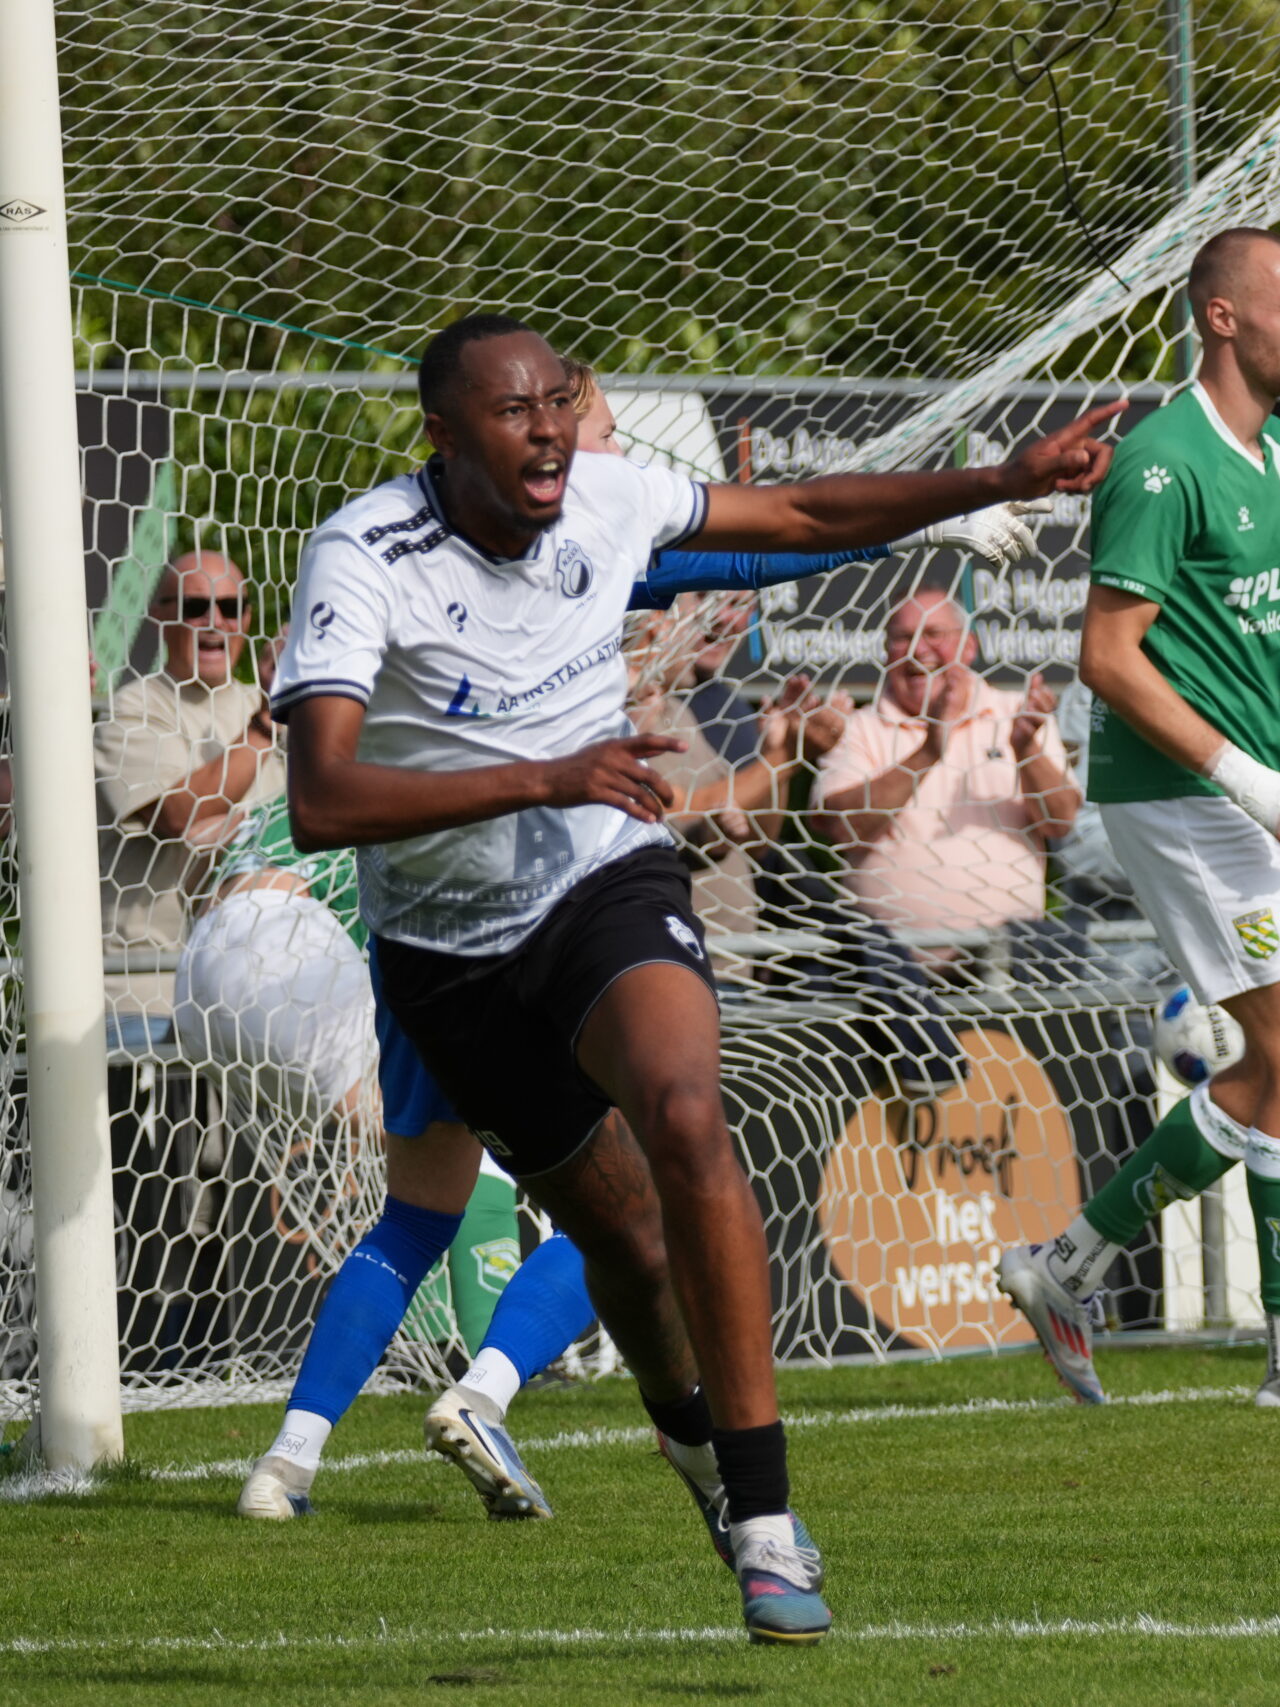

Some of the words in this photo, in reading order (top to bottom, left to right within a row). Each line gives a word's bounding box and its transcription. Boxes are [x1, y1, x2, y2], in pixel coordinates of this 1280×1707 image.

[6, 206, 32, 216] RAS
[973, 569, 1012, 613] De
[1122, 579, 1147, 595] 1932
[496, 693, 521, 713] AA
[936, 1188, 996, 1248] het
